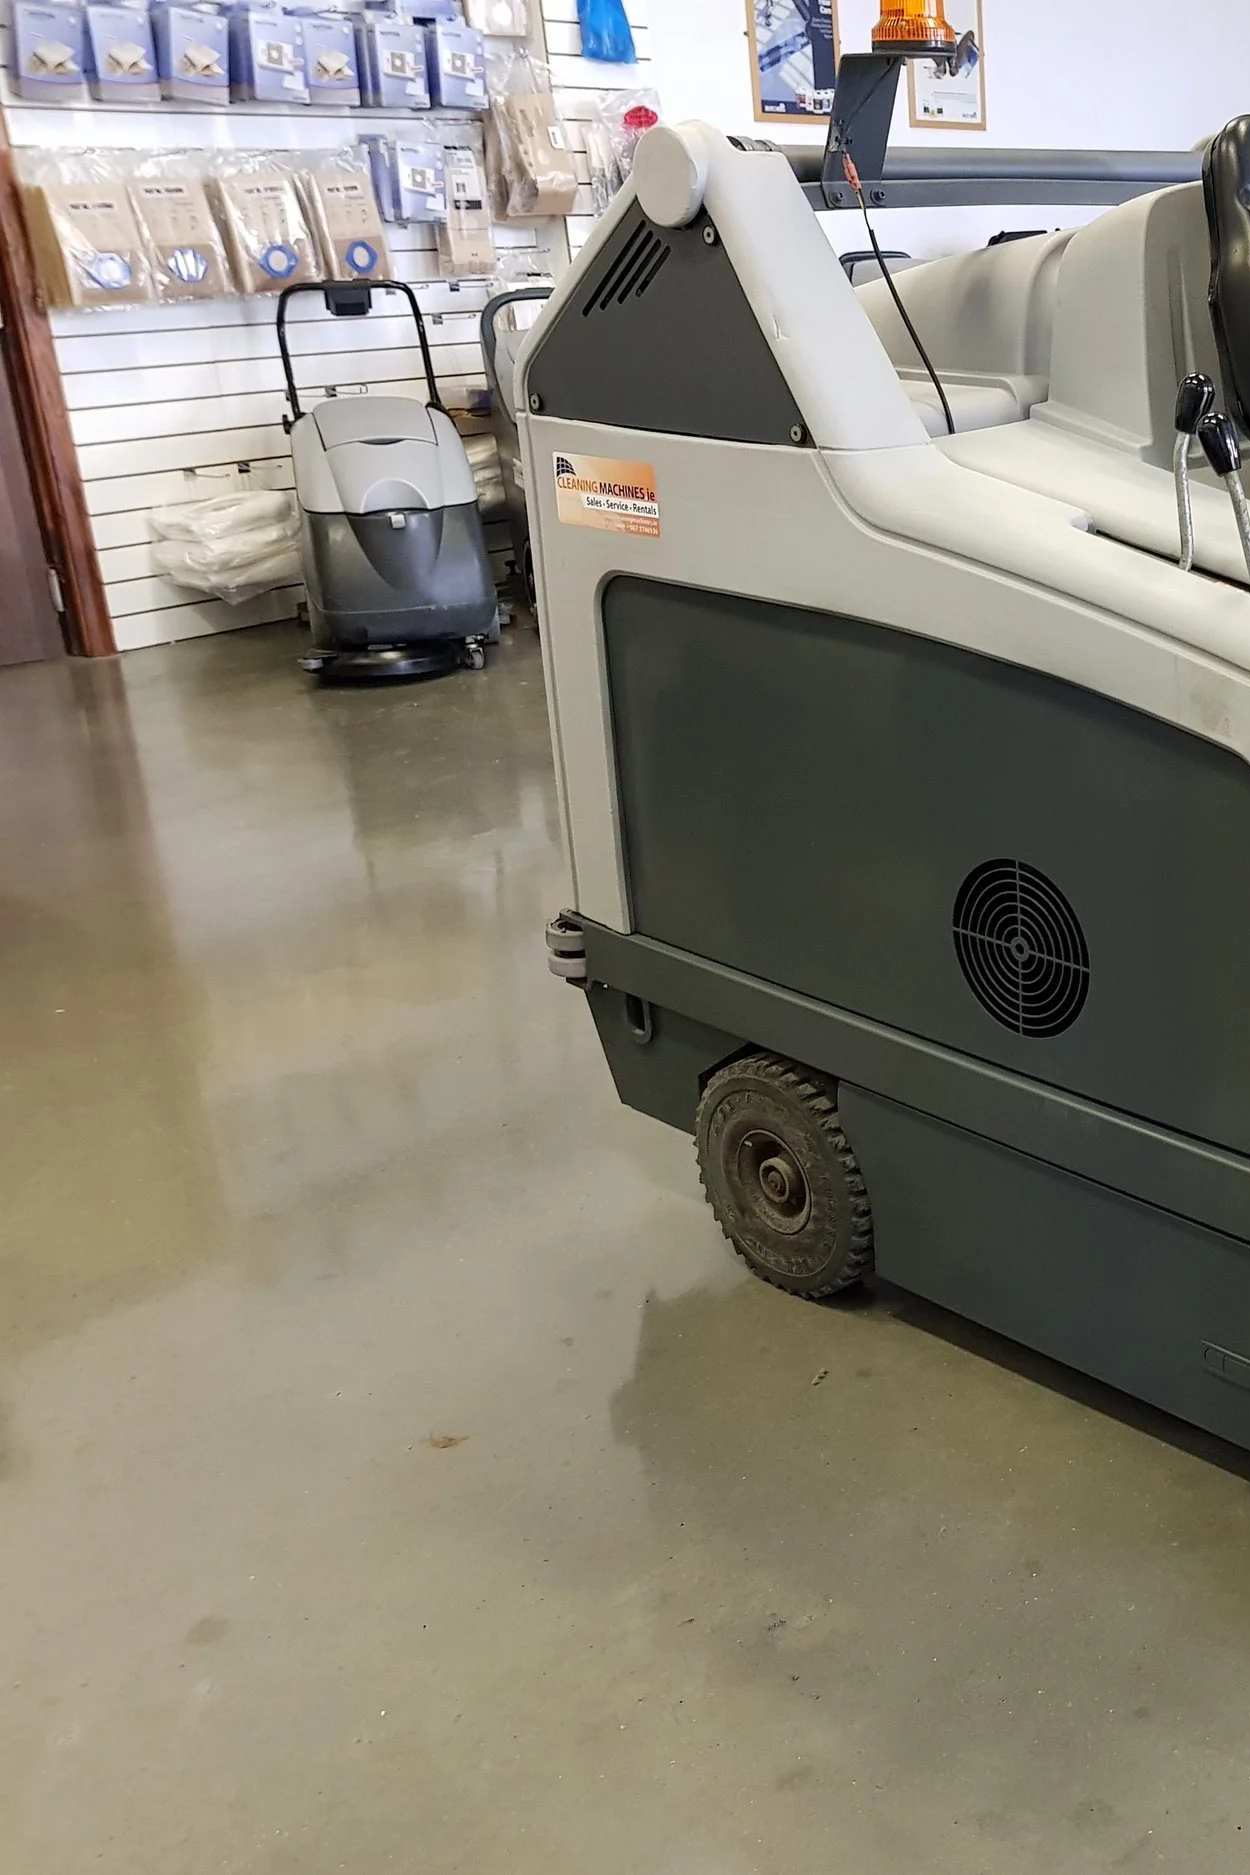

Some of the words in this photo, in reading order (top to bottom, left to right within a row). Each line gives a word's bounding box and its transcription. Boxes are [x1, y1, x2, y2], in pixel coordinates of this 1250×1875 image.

[557, 476, 598, 493] CLEANING
[599, 481, 645, 500] MACHINES
[586, 496, 603, 507] Sales
[606, 499, 629, 512] Service
[633, 503, 657, 516] Rentals
